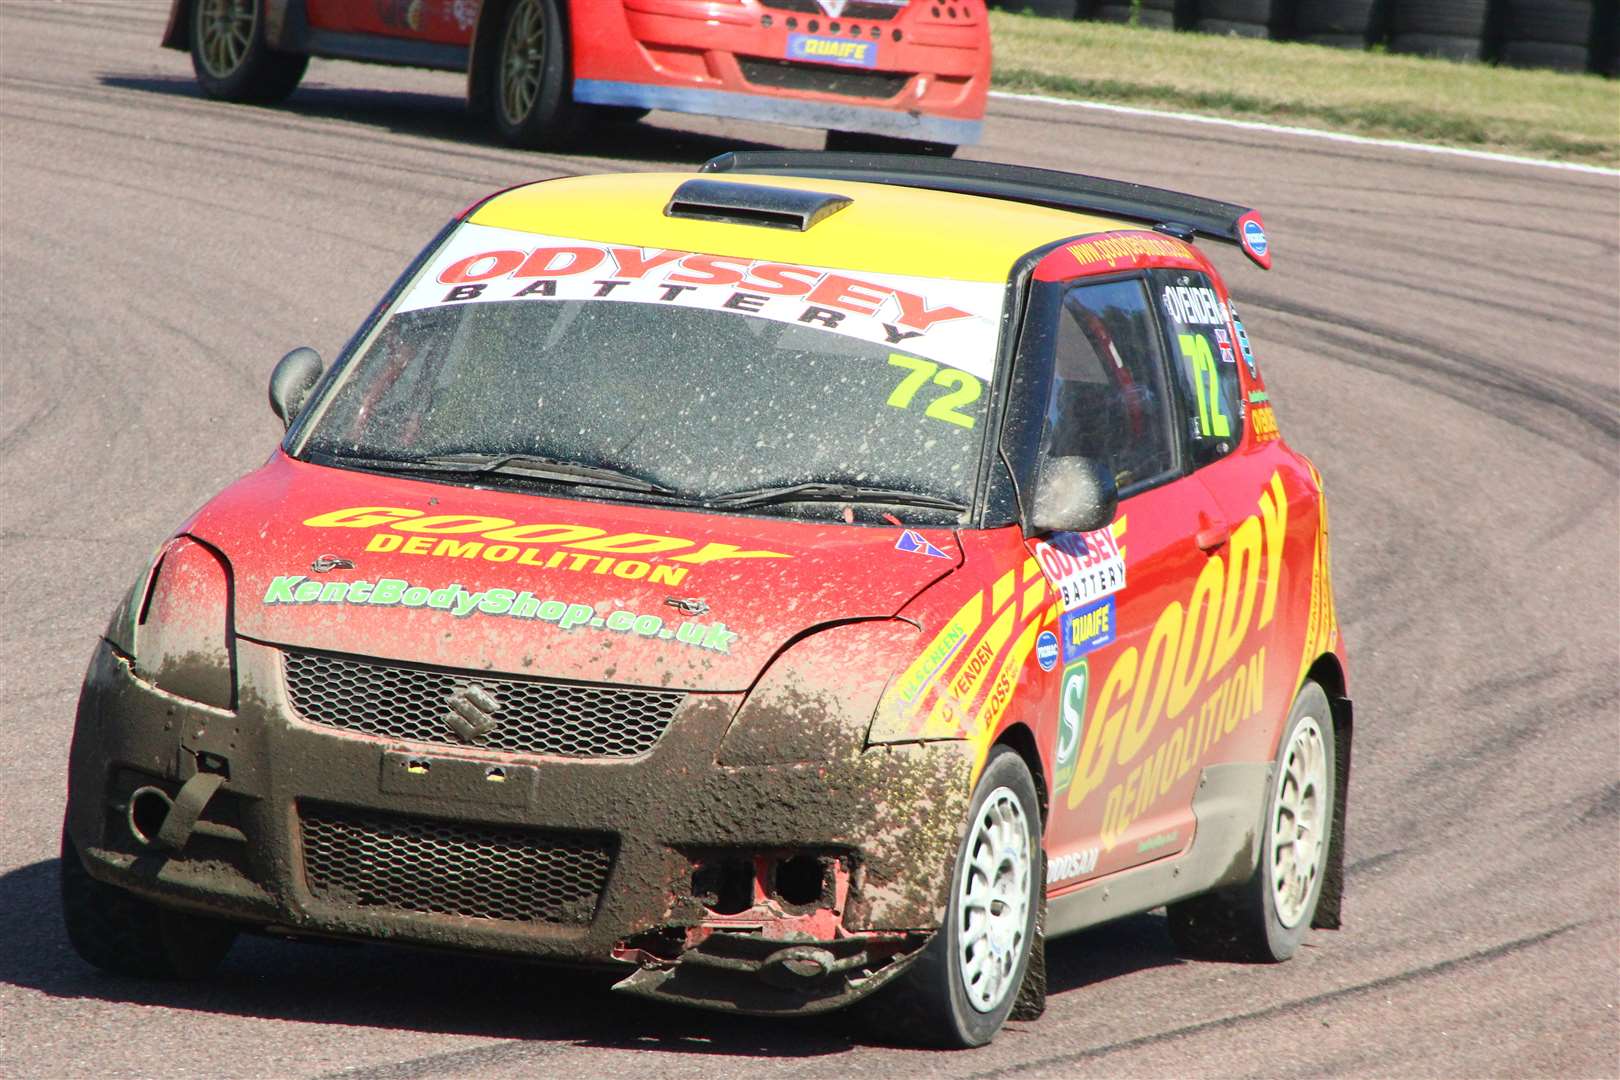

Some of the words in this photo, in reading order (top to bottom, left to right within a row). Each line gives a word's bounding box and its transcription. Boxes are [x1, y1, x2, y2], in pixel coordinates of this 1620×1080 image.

[804, 39, 868, 60] QUAIFE
[436, 245, 975, 331] ODYSSEY
[441, 279, 925, 344] BATTERY
[886, 353, 983, 429] 72
[1178, 333, 1230, 437] 72
[302, 507, 796, 564] GOODY
[365, 533, 688, 587] DEMOLITION
[263, 575, 740, 654] KentBodyShop.co.uk
[1062, 562, 1124, 606] BATTERY
[1068, 470, 1288, 810] GOODY
[1071, 604, 1111, 646] QUAIFE
[1101, 647, 1265, 852] DEMOLITION
